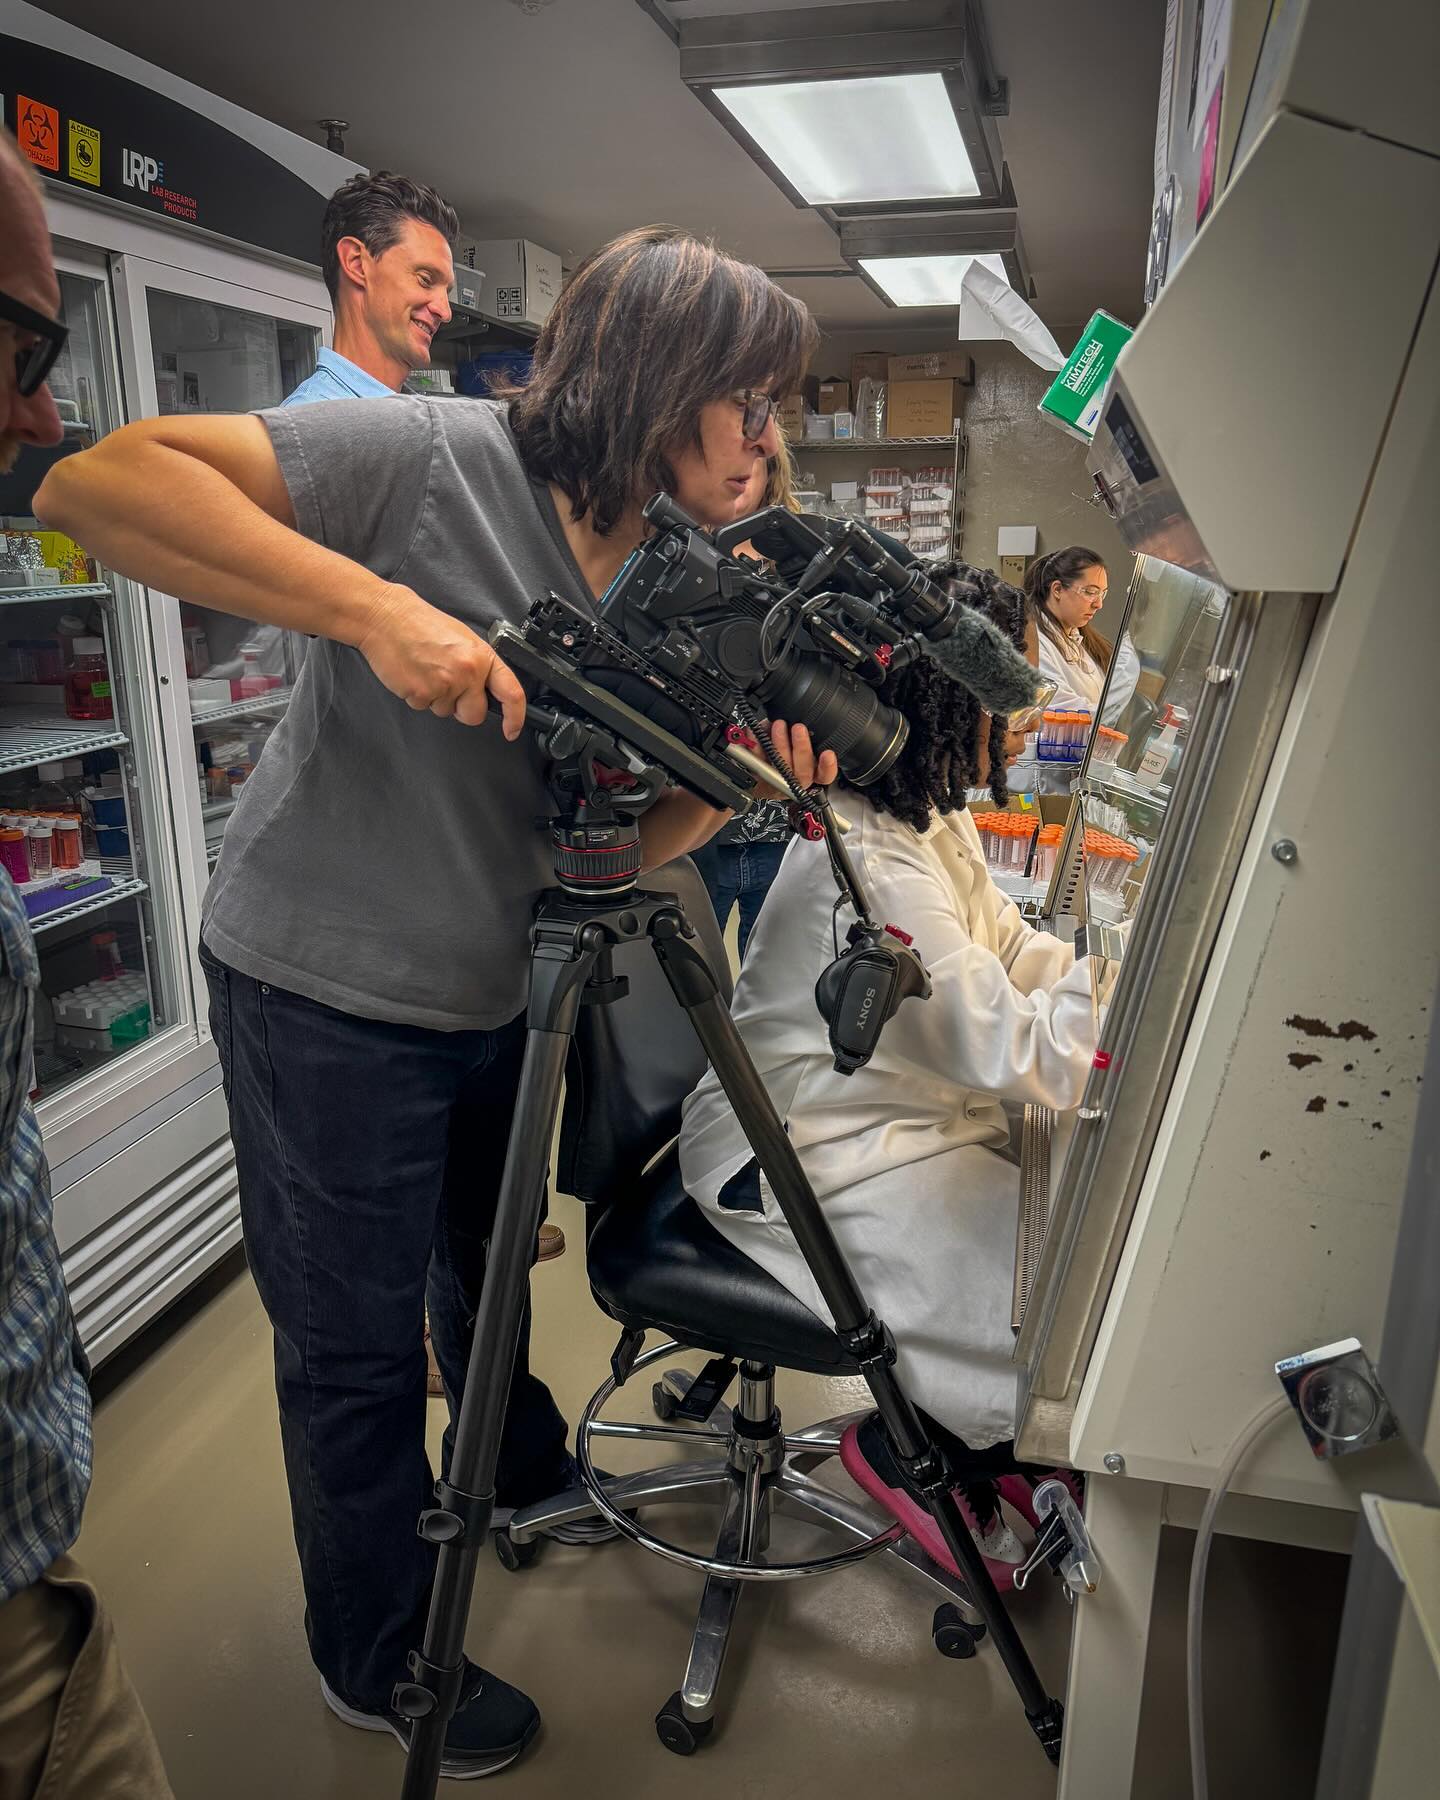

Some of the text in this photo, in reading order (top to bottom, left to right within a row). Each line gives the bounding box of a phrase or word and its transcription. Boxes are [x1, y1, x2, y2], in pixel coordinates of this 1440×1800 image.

[76, 123, 99, 139] CAUTION
[25, 148, 55, 165] OHAZARD
[122, 147, 158, 192] LRP
[151, 185, 197, 209] LAB RESEARCH
[163, 201, 197, 220] PRODUCTS
[1064, 339, 1099, 389] KIMTECH
[856, 987, 876, 1030] SONY
